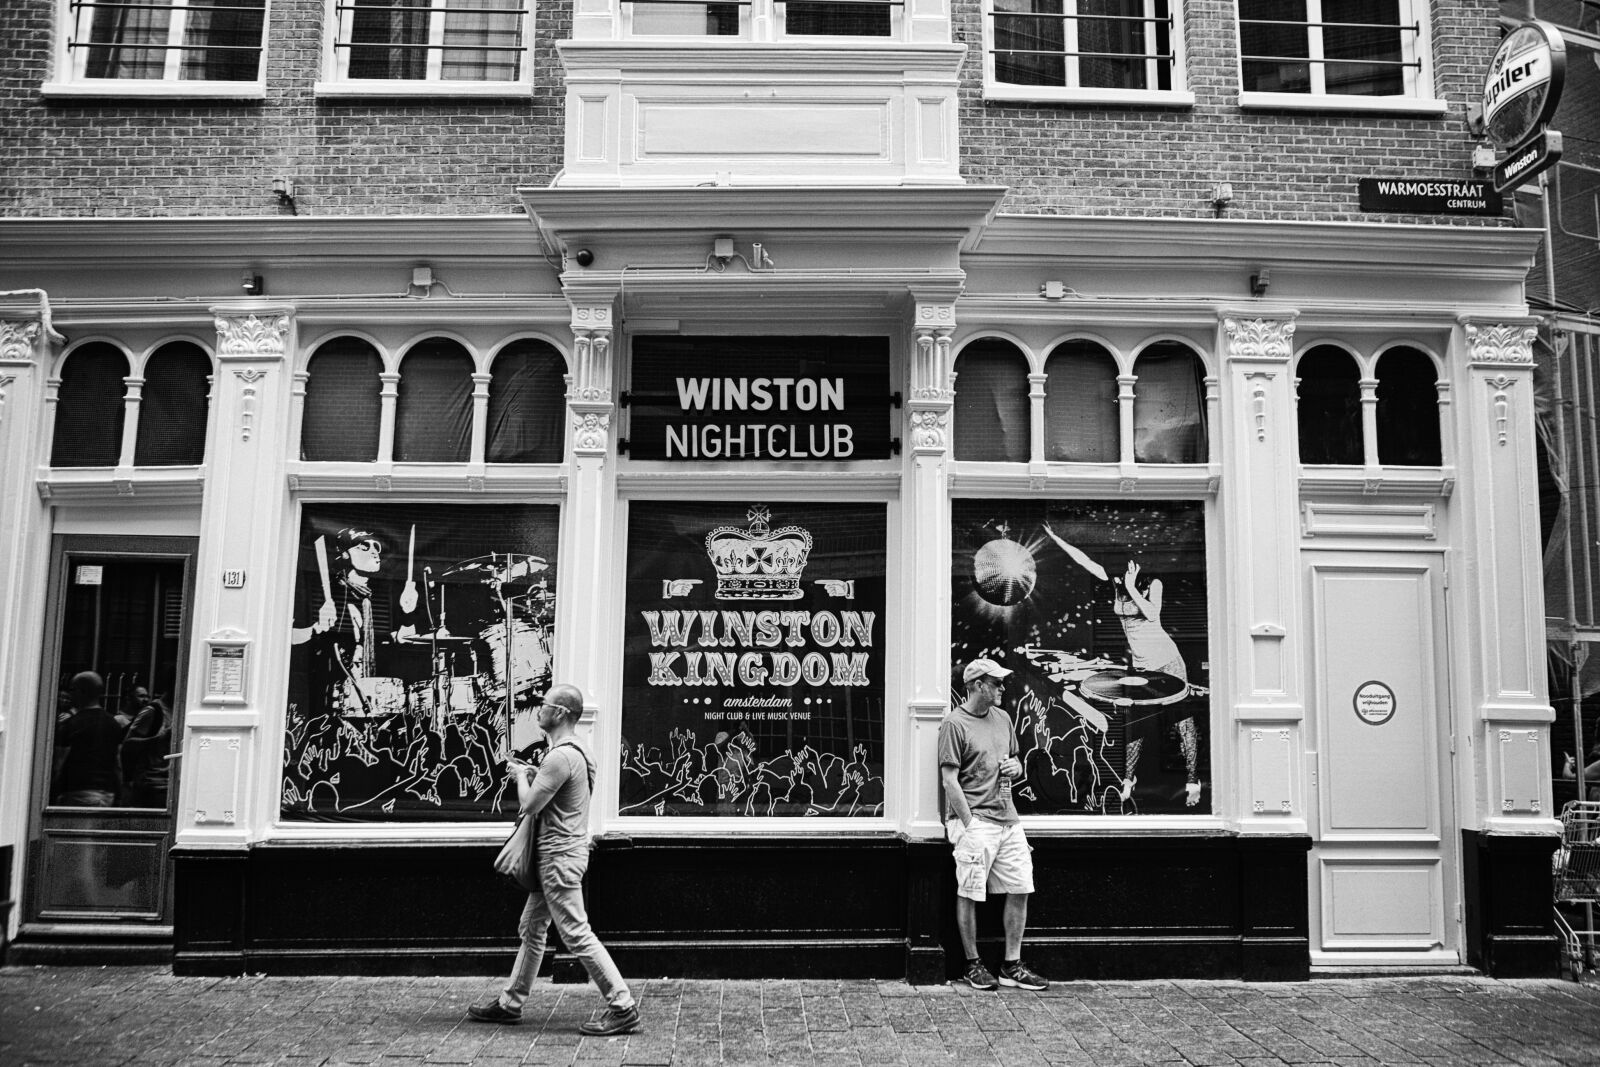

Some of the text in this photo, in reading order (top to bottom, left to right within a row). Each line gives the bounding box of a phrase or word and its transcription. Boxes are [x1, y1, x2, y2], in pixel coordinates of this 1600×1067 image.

[1486, 58, 1539, 107] upiler
[1504, 149, 1538, 179] Winston
[1377, 181, 1484, 198] WARMOESSTRAAT
[1446, 199, 1487, 209] CENTRUM
[675, 377, 845, 411] WINSTON
[665, 424, 854, 458] NIGHTCLUB
[227, 571, 240, 585] 131
[641, 610, 876, 647] WINSTON
[647, 652, 870, 687] KINGDOM
[704, 711, 812, 720] NIGHT CLUB & LIVE MUSIC VENUE
[723, 694, 793, 708] amsterdam
